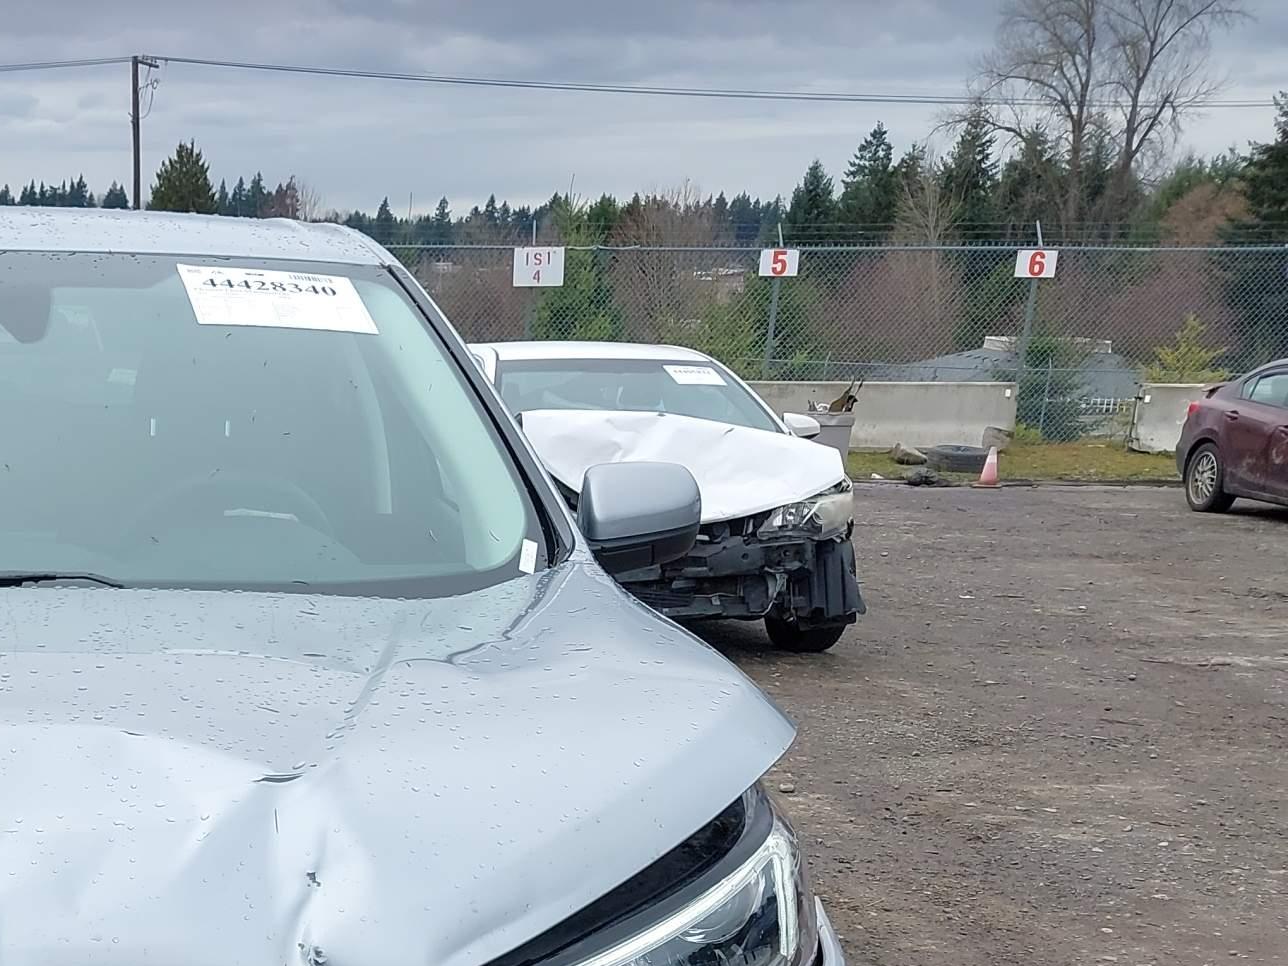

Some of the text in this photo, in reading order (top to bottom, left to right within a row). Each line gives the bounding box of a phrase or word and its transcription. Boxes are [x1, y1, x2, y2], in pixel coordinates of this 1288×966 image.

[771, 250, 788, 276] 5
[1028, 251, 1046, 277] 6
[202, 277, 338, 298] 44428340
[532, 269, 541, 284] 4
